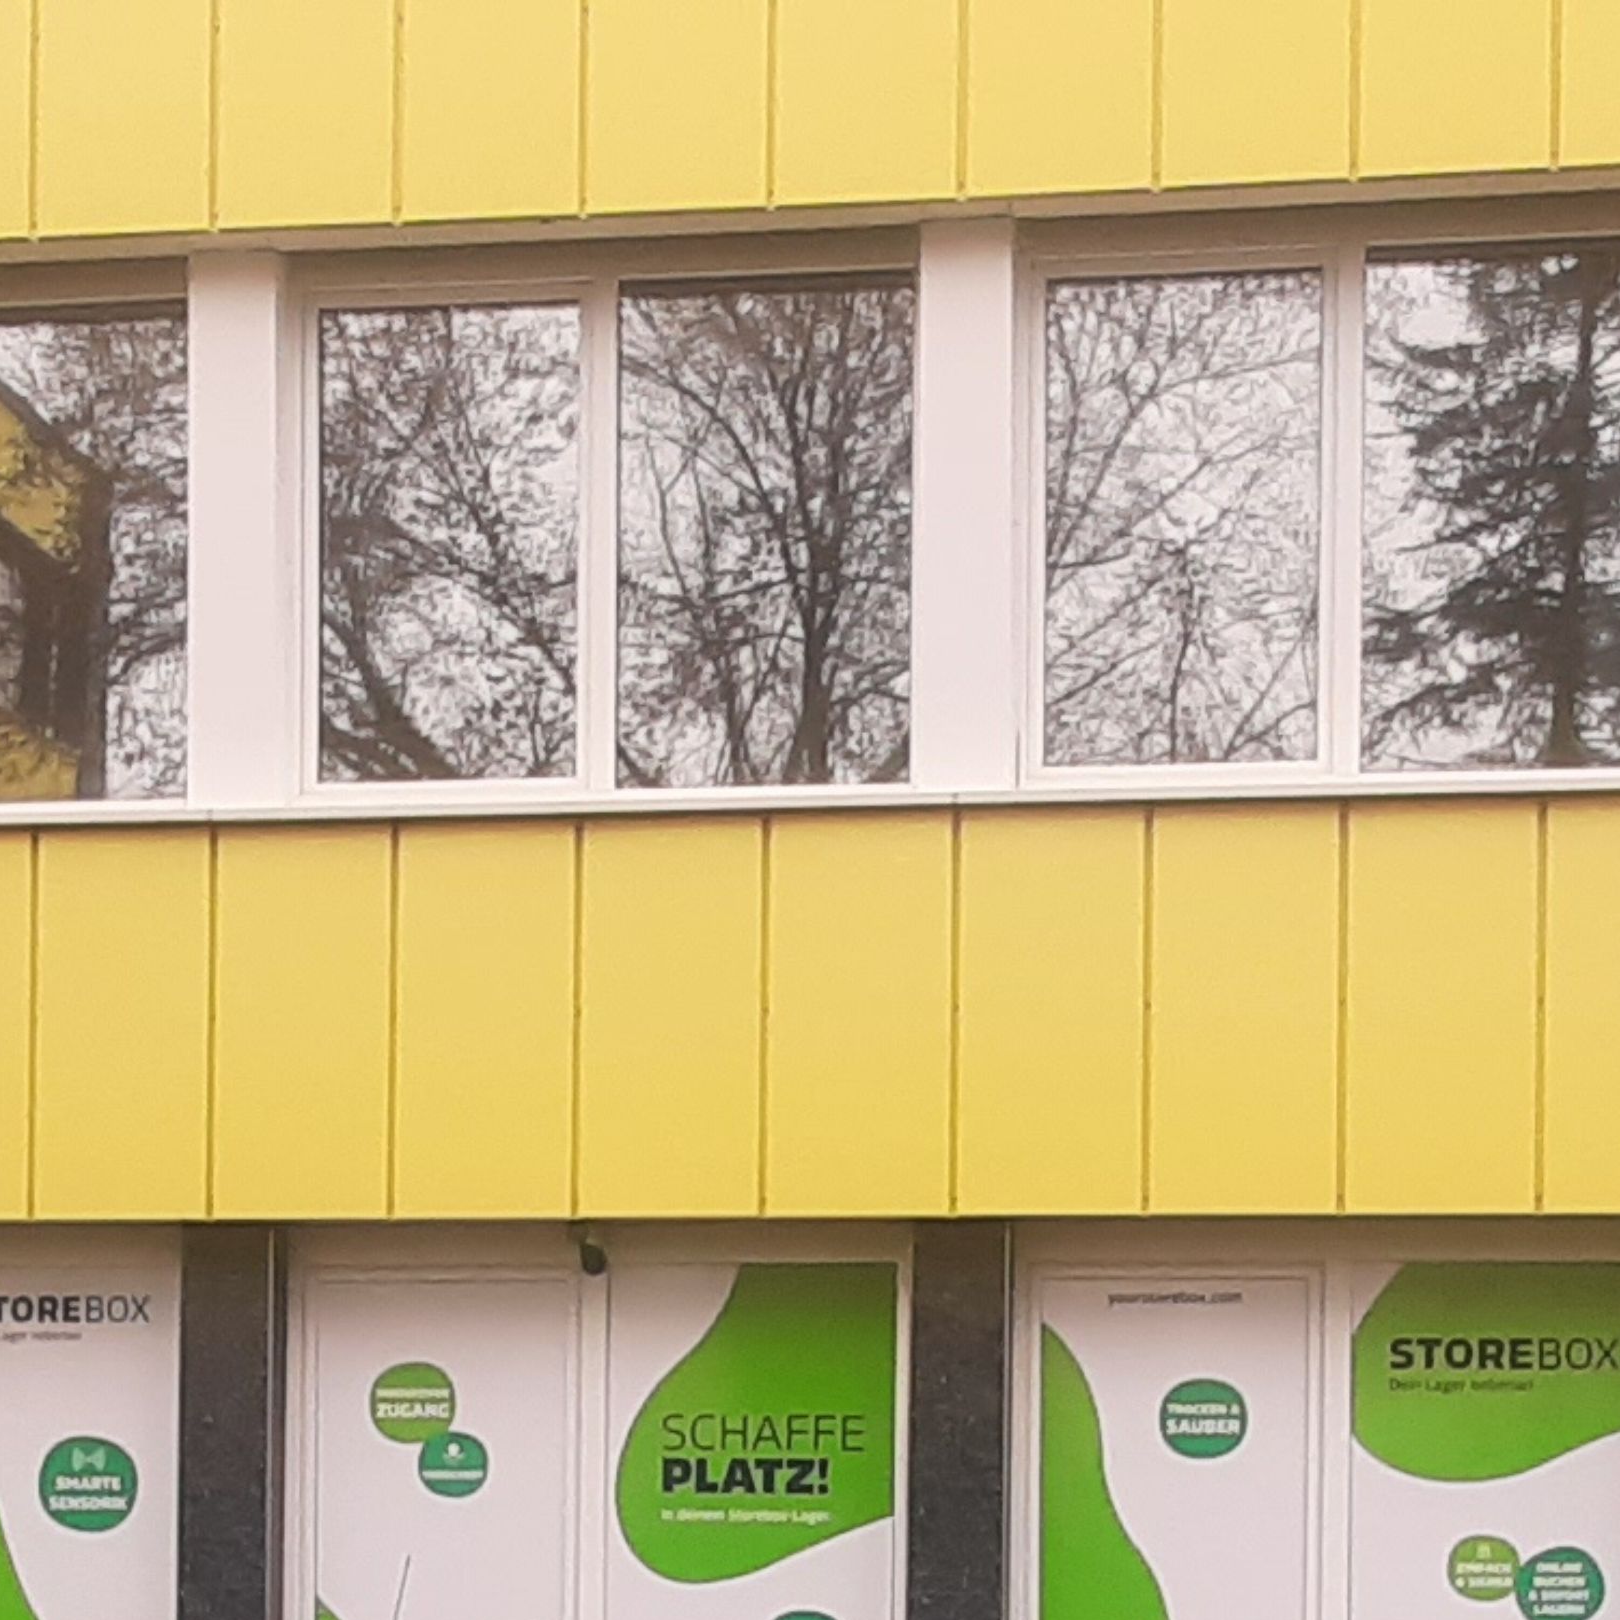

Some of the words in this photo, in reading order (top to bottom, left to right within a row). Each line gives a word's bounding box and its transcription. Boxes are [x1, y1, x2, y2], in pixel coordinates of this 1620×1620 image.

[1390, 1337, 1619, 1370] STOREBOX
[376, 1401, 450, 1418] ZUGANG
[661, 1413, 866, 1451] SCHAFFE
[1166, 1418, 1240, 1434] SAUBER
[54, 1475, 122, 1491] SMARTE
[662, 1457, 829, 1494] PLATZ!
